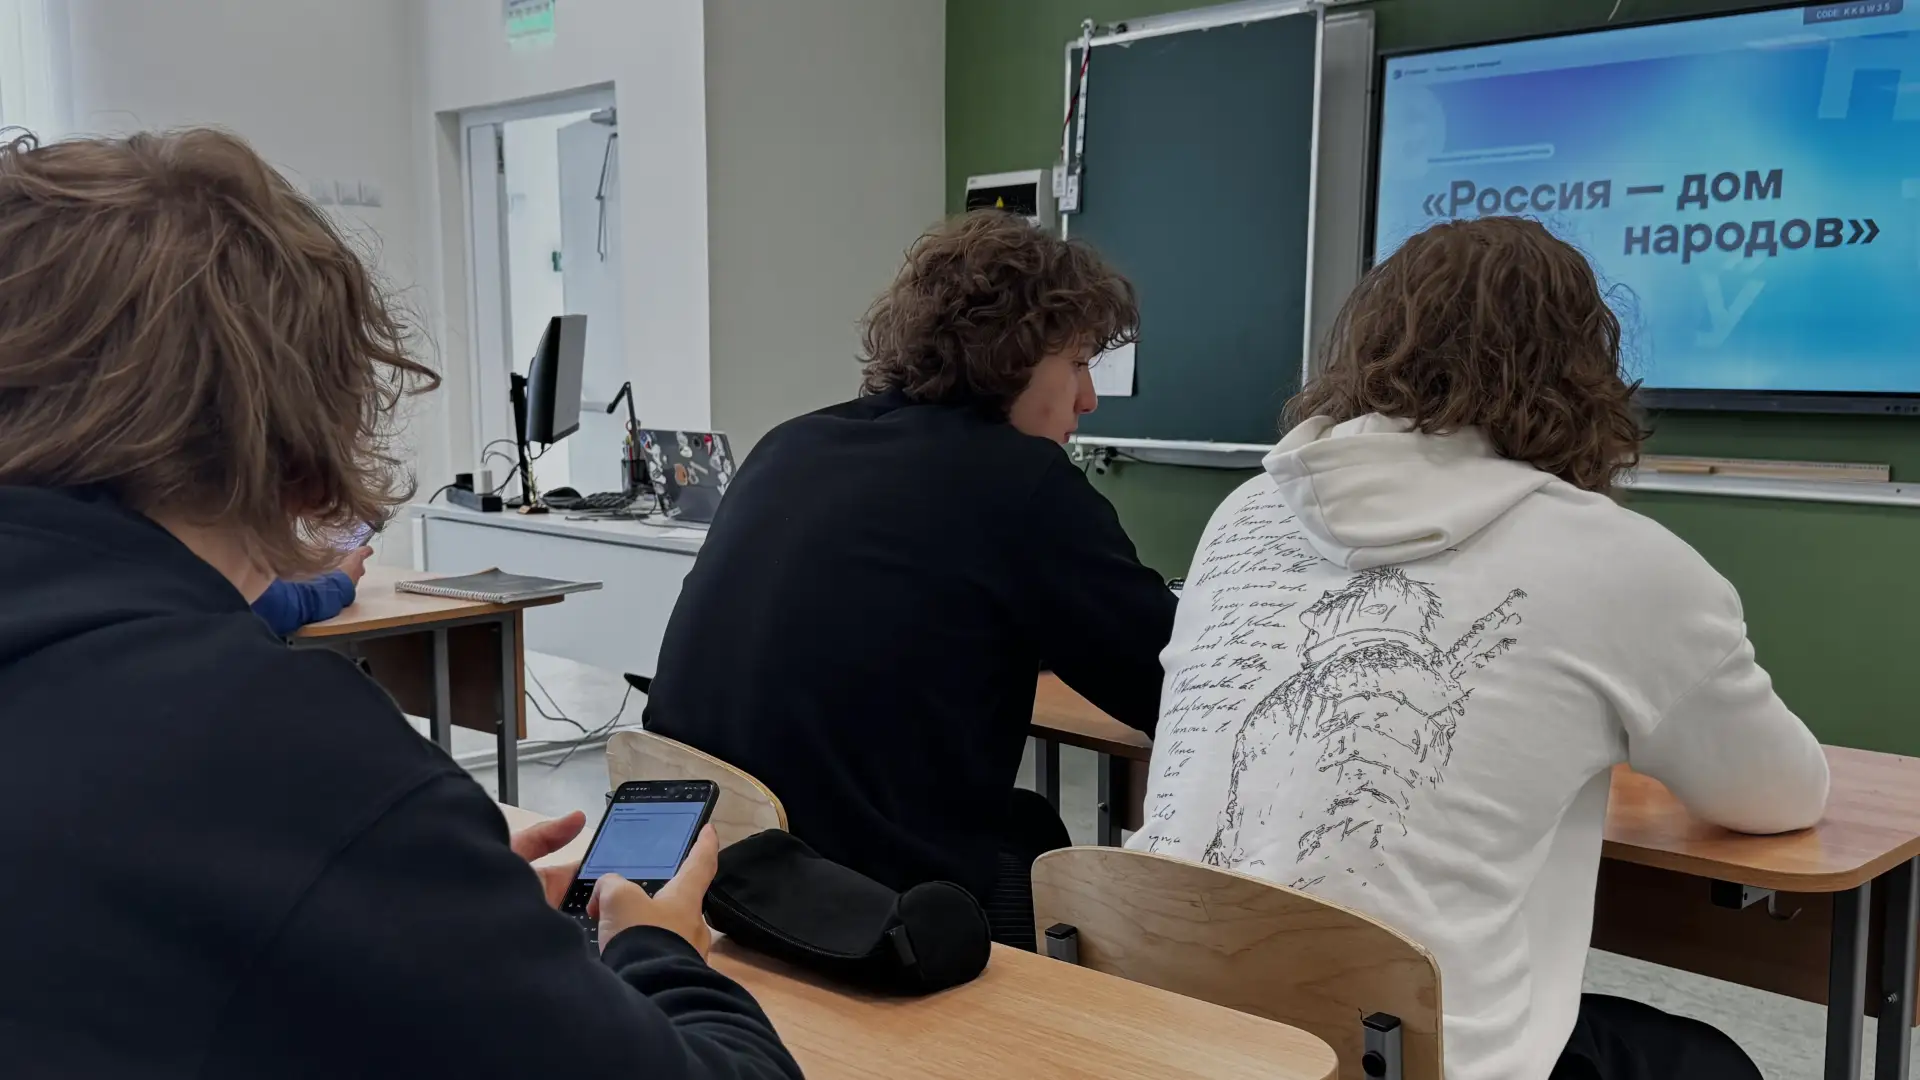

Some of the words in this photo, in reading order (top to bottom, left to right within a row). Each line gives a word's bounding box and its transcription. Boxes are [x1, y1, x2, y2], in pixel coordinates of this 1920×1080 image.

[1422, 180, 1611, 217] «Россия
[1676, 169, 1783, 211] дом
[1624, 217, 1880, 264] народов»
